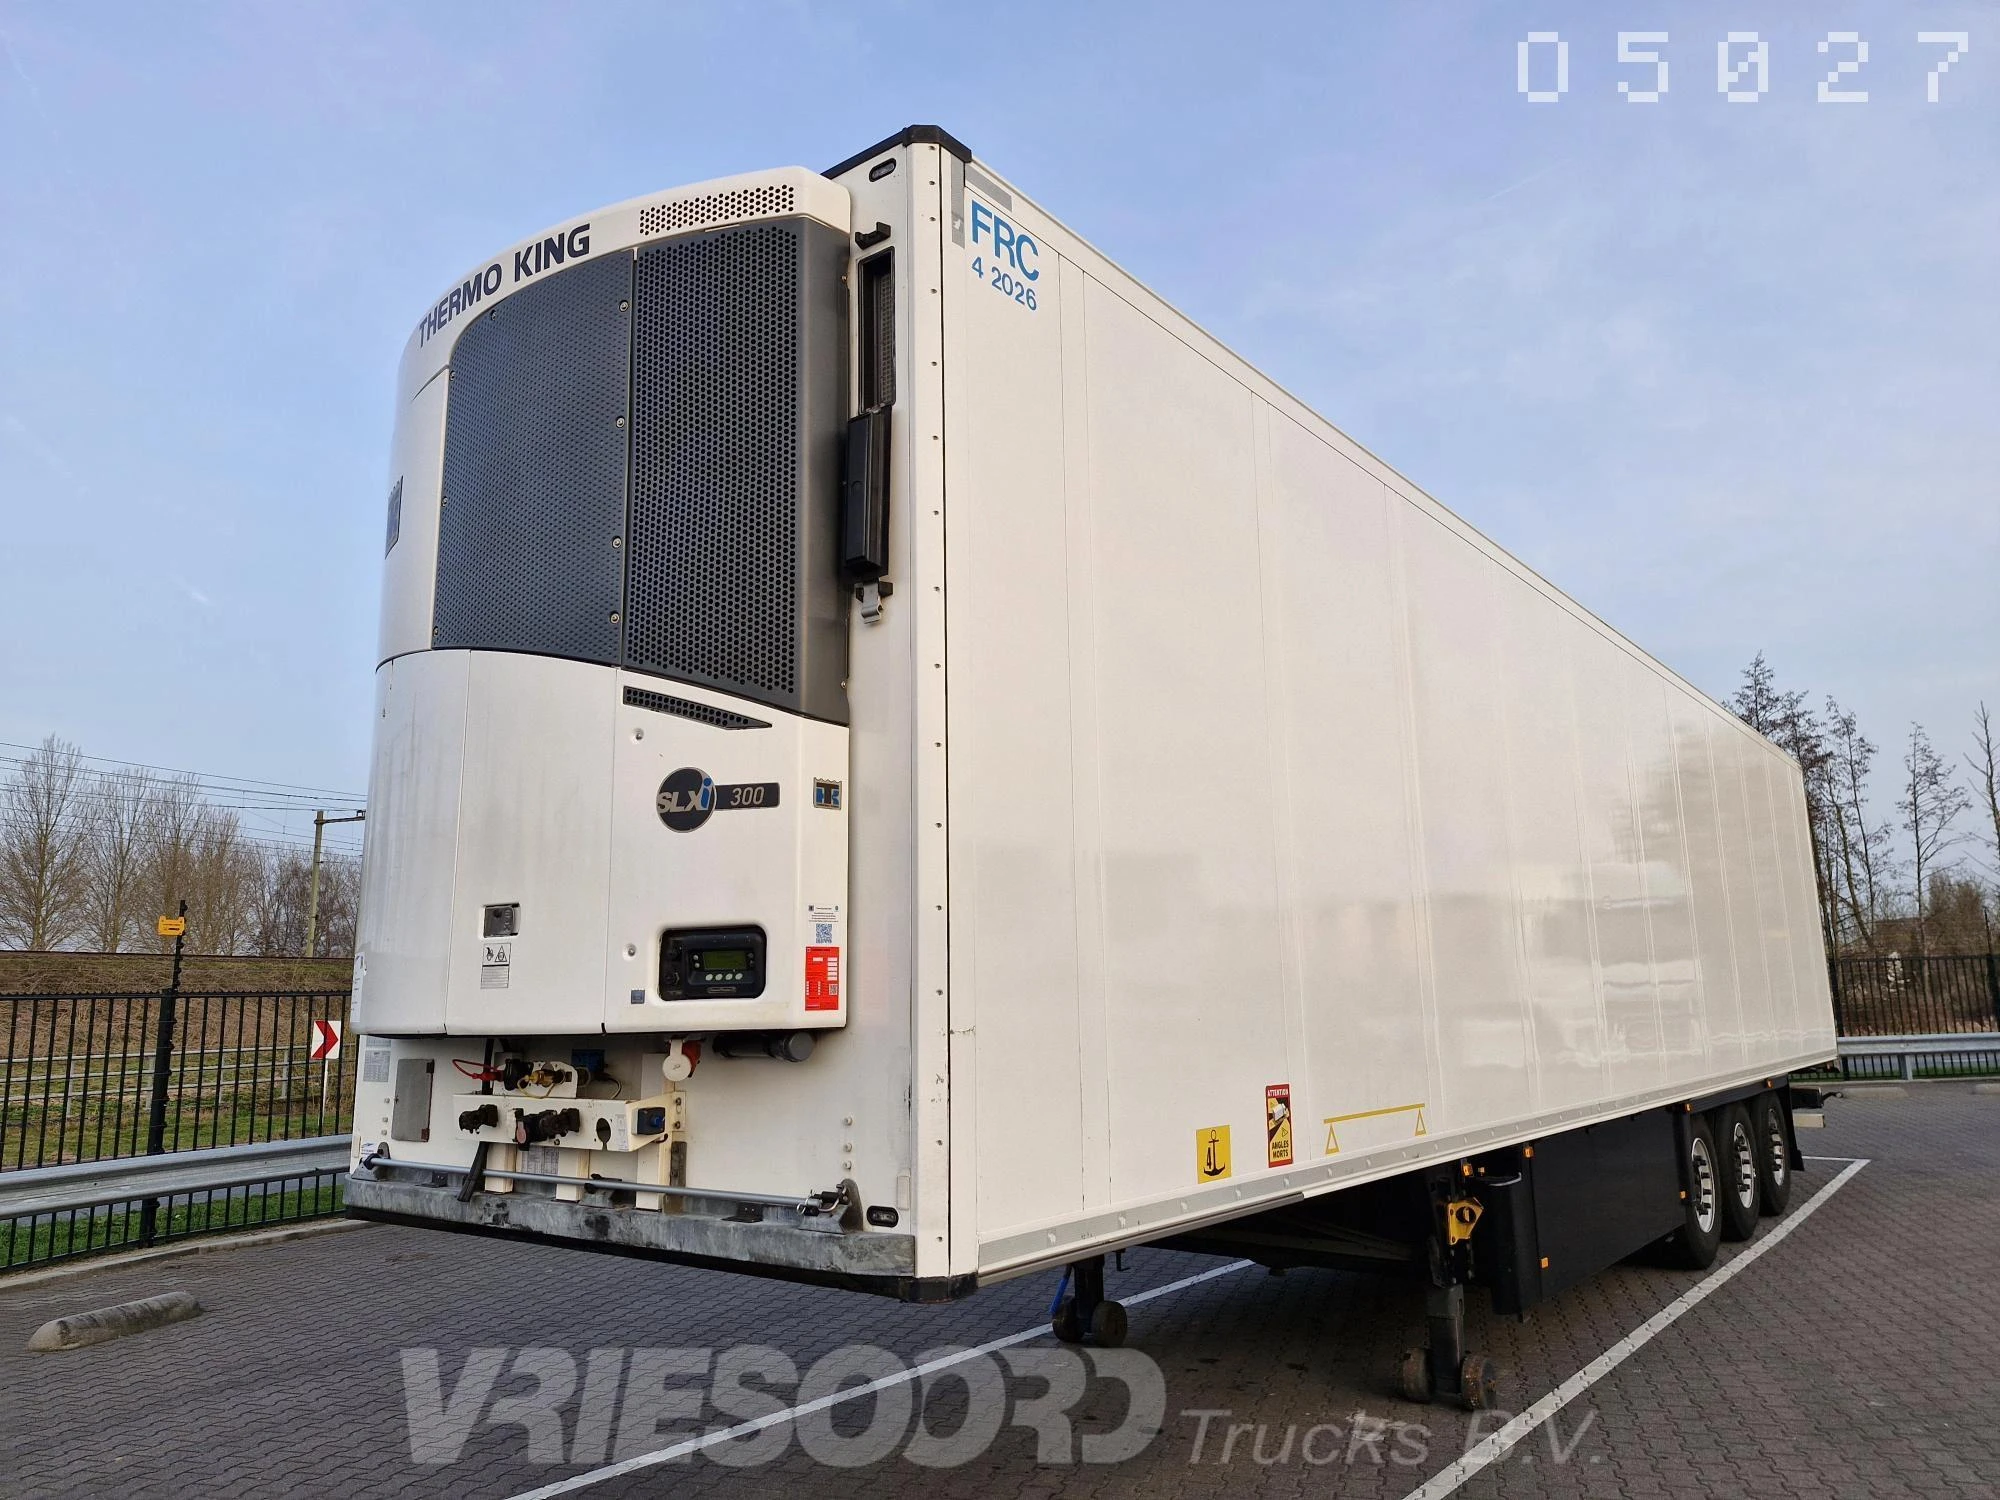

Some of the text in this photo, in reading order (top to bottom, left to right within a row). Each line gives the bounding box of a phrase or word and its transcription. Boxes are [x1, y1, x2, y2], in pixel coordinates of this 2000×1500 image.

[972, 200, 1040, 281] FRC
[419, 223, 591, 348] THERMO KING
[972, 257, 1037, 311] 4 2026
[730, 787, 765, 806] 300
[1272, 1140, 1289, 1150] ANGLES
[1272, 1149, 1288, 1159] MORTS
